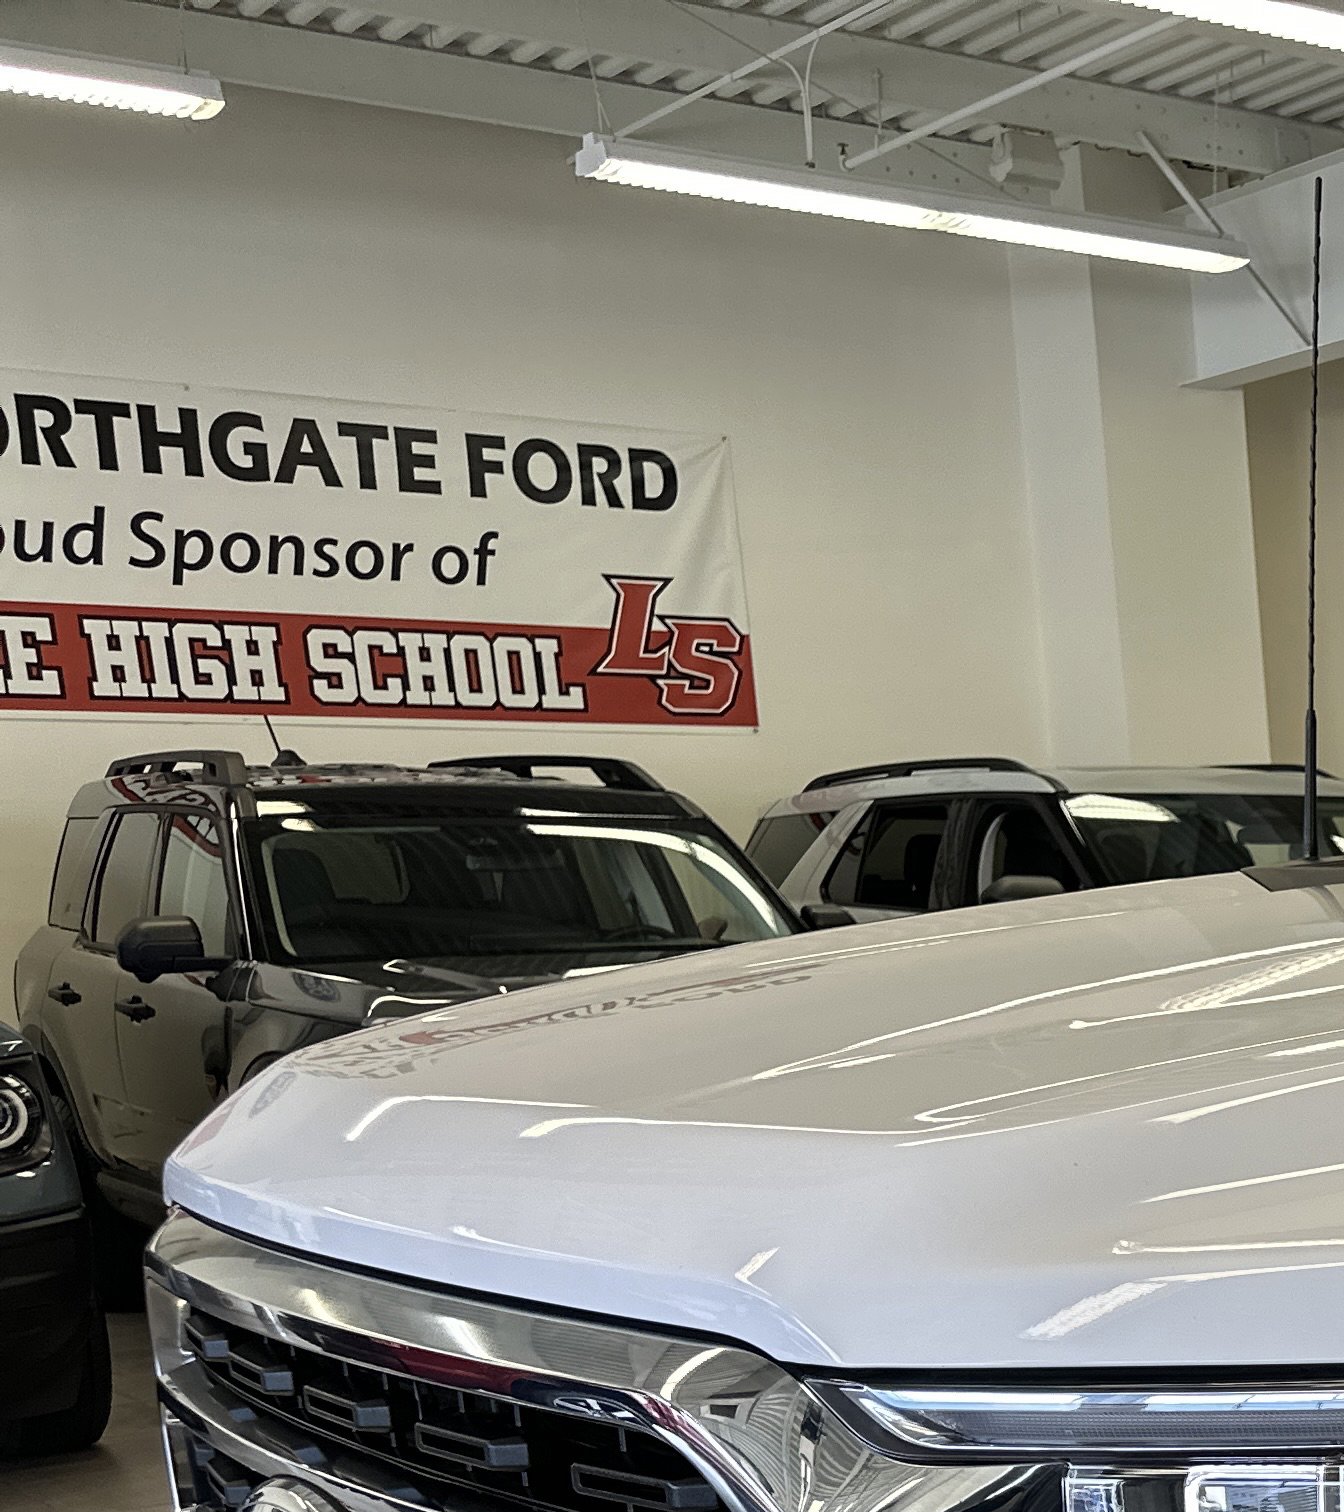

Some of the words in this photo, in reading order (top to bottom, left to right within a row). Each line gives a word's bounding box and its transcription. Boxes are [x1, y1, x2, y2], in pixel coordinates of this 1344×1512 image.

[0, 393, 443, 495] RTHGATE
[466, 432, 679, 512] FORD
[0, 505, 106, 566] ud
[128, 510, 415, 587] Sponsor
[431, 530, 500, 587] of
[79, 615, 292, 705] HIGH
[303, 626, 590, 713] SCHOOL
